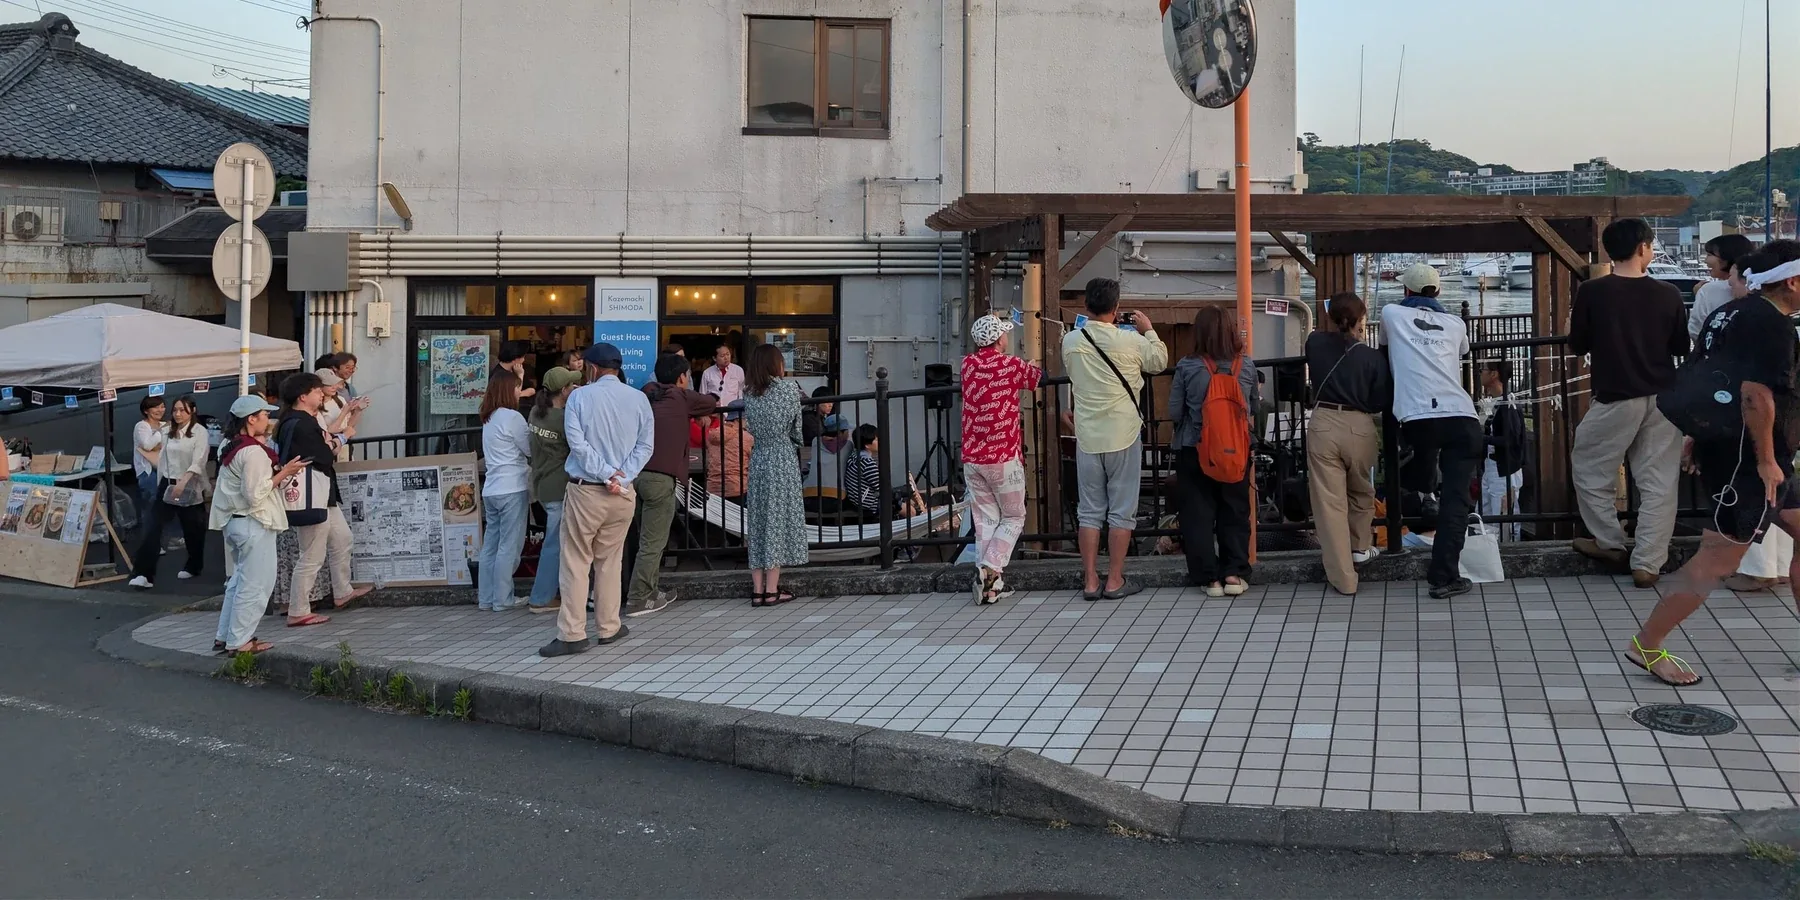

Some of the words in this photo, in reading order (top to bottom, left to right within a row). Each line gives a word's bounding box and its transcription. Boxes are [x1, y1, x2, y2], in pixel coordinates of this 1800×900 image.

[607, 295, 645, 303] Kazemachi
[600, 333, 624, 341] Guest
[626, 333, 651, 341] House
[620, 362, 647, 372] orking
